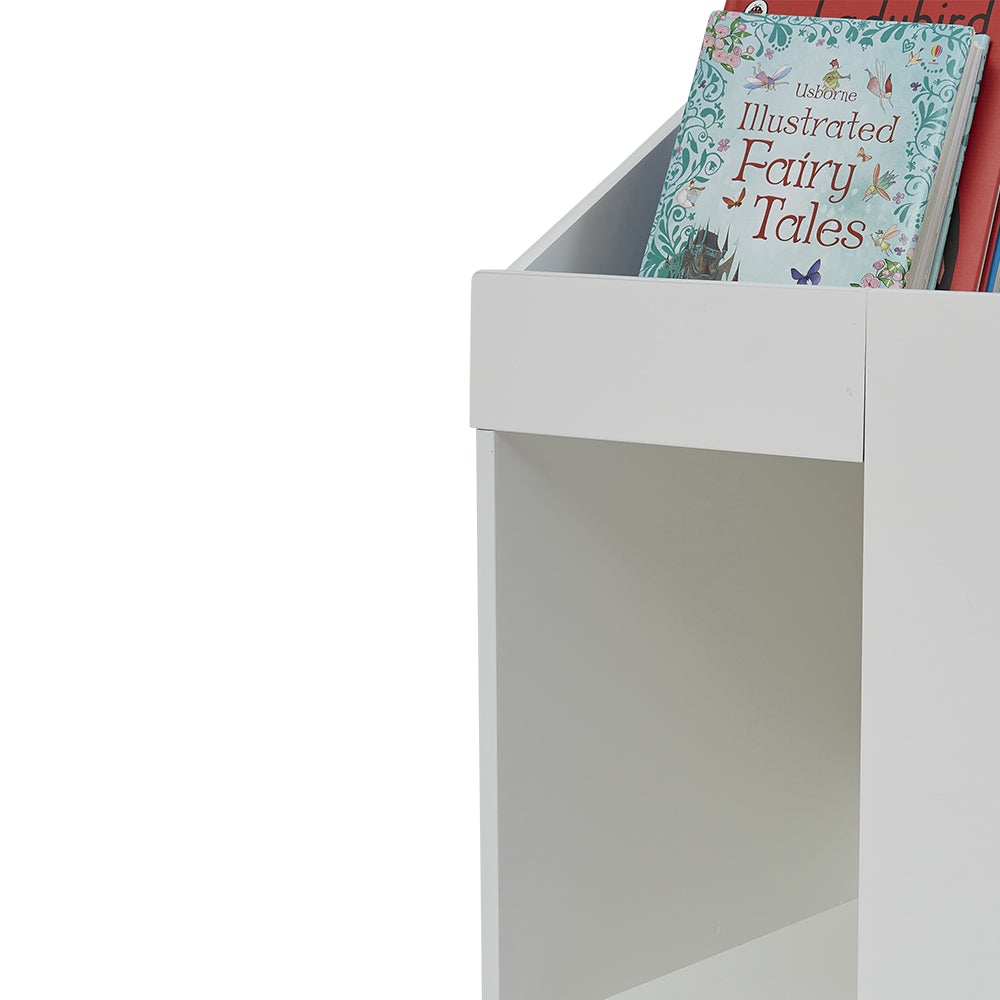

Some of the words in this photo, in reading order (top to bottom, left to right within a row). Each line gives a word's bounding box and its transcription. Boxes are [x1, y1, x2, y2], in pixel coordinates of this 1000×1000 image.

[815, 0, 995, 35] dbird
[795, 83, 858, 102] Usborne
[737, 102, 901, 143] Illustrated
[731, 138, 857, 204] Fairy
[752, 194, 867, 249] Tales
